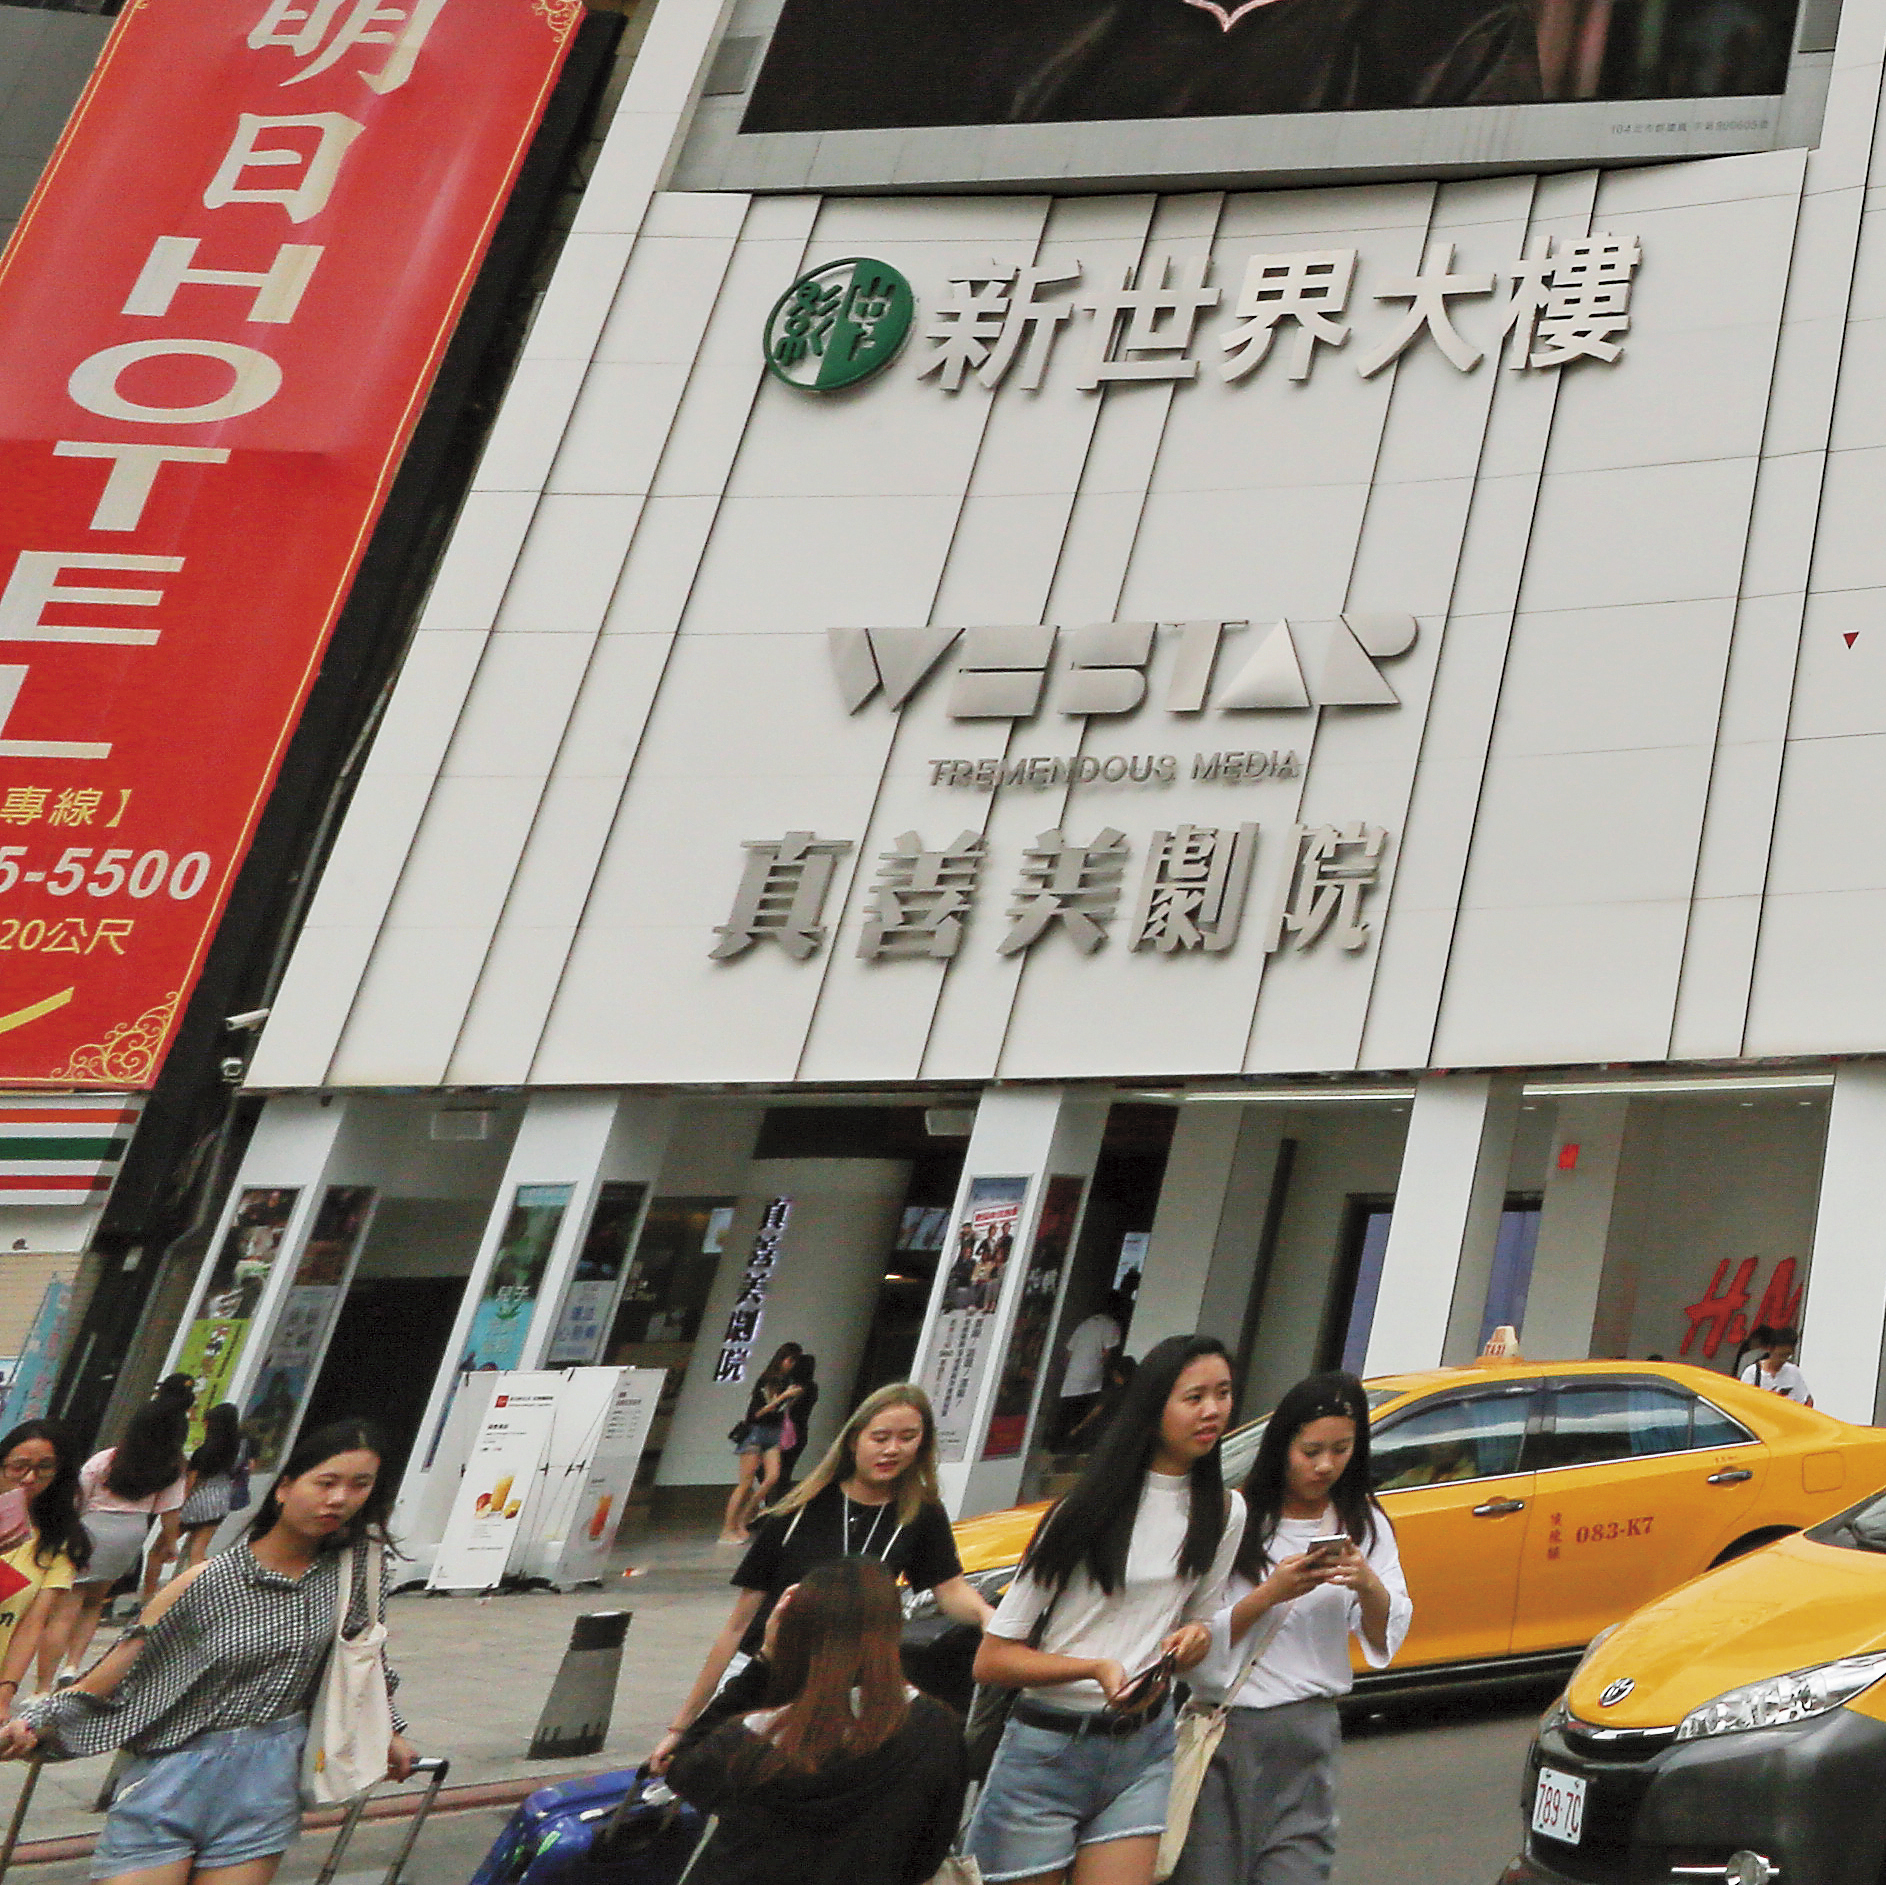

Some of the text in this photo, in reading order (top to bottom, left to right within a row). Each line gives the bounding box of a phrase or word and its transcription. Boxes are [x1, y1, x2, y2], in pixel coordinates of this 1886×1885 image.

[917, 230, 1643, 394] 新世界大樓
[928, 748, 1304, 790] TREMENDOUS MEDIA
[708, 819, 1390, 961] 真善美劇院
[1576, 1516, 1654, 1544] 083-K7
[1536, 1783, 1581, 1833] 789-7C
